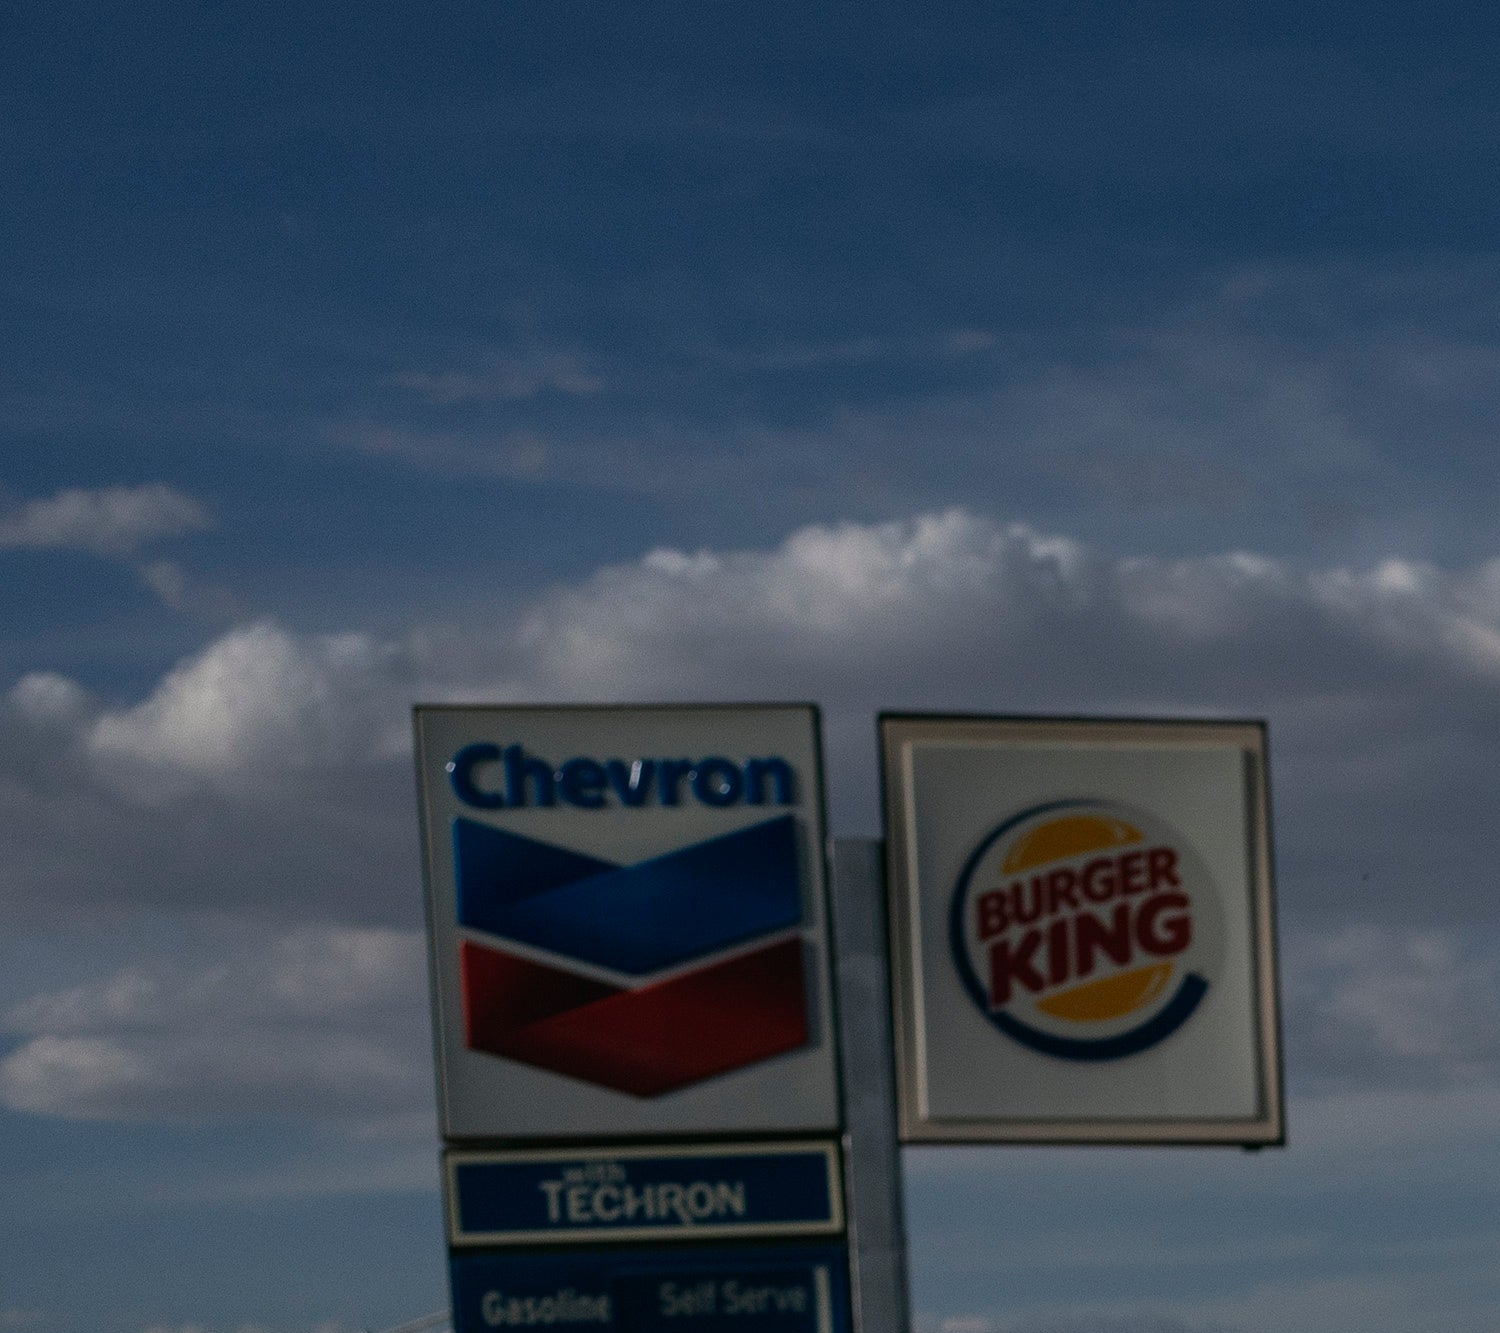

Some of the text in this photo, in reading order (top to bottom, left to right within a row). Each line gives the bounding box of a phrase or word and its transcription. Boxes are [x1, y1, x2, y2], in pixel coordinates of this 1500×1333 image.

[449, 741, 796, 810] Chevron
[977, 846, 1182, 940] BURGER
[988, 893, 1192, 1013] KING
[538, 1181, 746, 1226] TECHRON
[481, 1279, 807, 1327] Gasoline Self Serve
